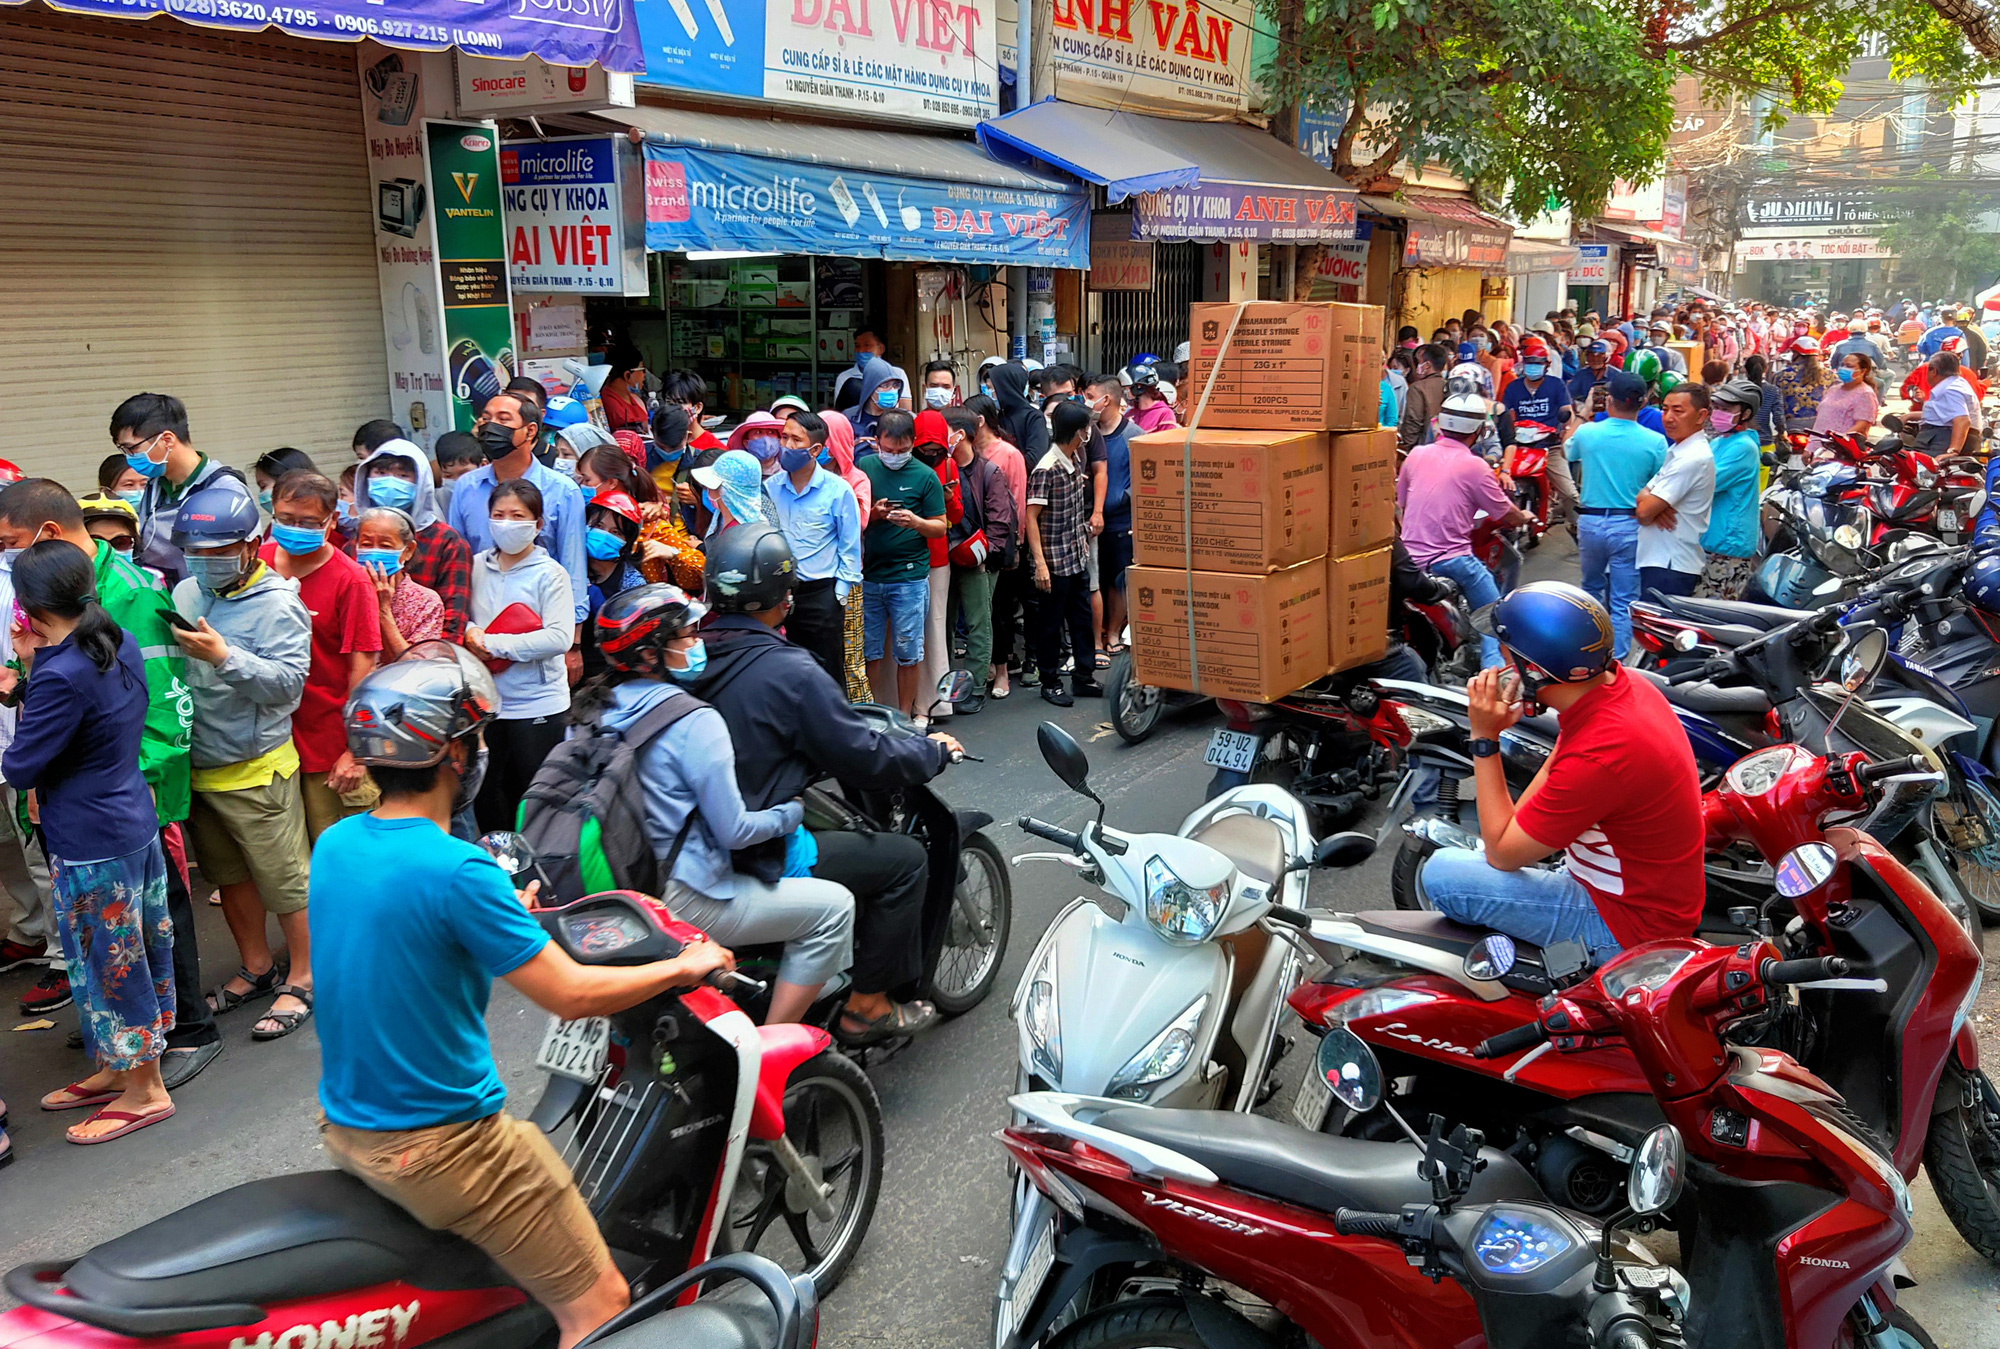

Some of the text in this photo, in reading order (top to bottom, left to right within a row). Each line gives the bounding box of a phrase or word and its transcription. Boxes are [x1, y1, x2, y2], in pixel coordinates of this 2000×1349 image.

[334, 14, 448, 42] 0906.927.215
[452, 28, 503, 50] (LOAN)
[1063, 37, 1091, 57] CUNG
[1127, 52, 1133, 67] &
[1136, 50, 1147, 69] LẺ
[1149, 55, 1167, 73] CÁC
[1169, 61, 1191, 80] DỤNG
[1193, 67, 1205, 85] CỤ
[1206, 69, 1212, 83] Y
[1213, 72, 1234, 88] KHOA
[782, 48, 991, 98] CUNG CẤP SỈ & LẺ CÁC MẶT HÀNG DỤNG CỤ Y KHOA
[472, 76, 526, 93] Sinocare
[785, 79, 793, 91] 12
[835, 85, 854, 100] THANH
[858, 89, 869, 101] P.15
[873, 91, 885, 103] Q.10
[1669, 112, 1705, 133] CẤP
[462, 137, 489, 148] Kowa
[521, 149, 594, 174] microlife
[531, 187, 609, 217] CỤ Y KHOA
[646, 173, 817, 216] Swiss microlife
[948, 186, 1023, 206] DỤNG CỤ Y KHOA &
[444, 208, 494, 219] VANTELIN
[1174, 194, 1190, 222] CỤ
[1192, 196, 1201, 218] Y
[1202, 196, 1231, 219] KHOA
[1234, 195, 1297, 222] ANH
[1304, 193, 1355, 224] VÂN
[1843, 209, 1856, 220] TÔ
[714, 211, 721, 222] A
[721, 212, 750, 224] partner
[750, 212, 762, 224] for
[791, 217, 803, 227] For
[932, 206, 1069, 244] ĐẠI VIỆT
[1160, 221, 1187, 237] NGUYỄN
[1244, 227, 1257, 239] Q.10
[508, 215, 612, 272] ẠI VIỆT
[1582, 264, 1605, 277] ĐỨC
[550, 276, 573, 286] THANH
[578, 277, 593, 287] P.15
[599, 277, 614, 287] Q.10
[1214, 272, 1221, 292] Y
[1240, 271, 1247, 291] Y
[1238, 317, 1287, 326] VINAHANKOOK
[1269, 327, 1300, 336] SYRINGE
[1233, 338, 1291, 347] STERILE SYRINGE
[1253, 361, 1270, 369] 23G
[1253, 396, 1288, 404] 1200PCS
[1175, 470, 1223, 479] VINHANKOOK
[190, 513, 216, 522] BOSCH
[1209, 535, 1235, 547] CHIẾC
[1172, 599, 1220, 610] VINAANKOOK
[1207, 665, 1233, 676] CHIẾC
[1904, 659, 1934, 678] YAMAHA
[1216, 732, 1251, 752] 59-U2
[1206, 750, 1248, 770] 044.94
[1112, 951, 1146, 968] HONDA
[669, 1113, 725, 1140] HONDA
[1142, 1190, 1265, 1237] VISION
[1799, 1255, 1851, 1270] HONDA
[229, 1298, 421, 1349] HONEY
